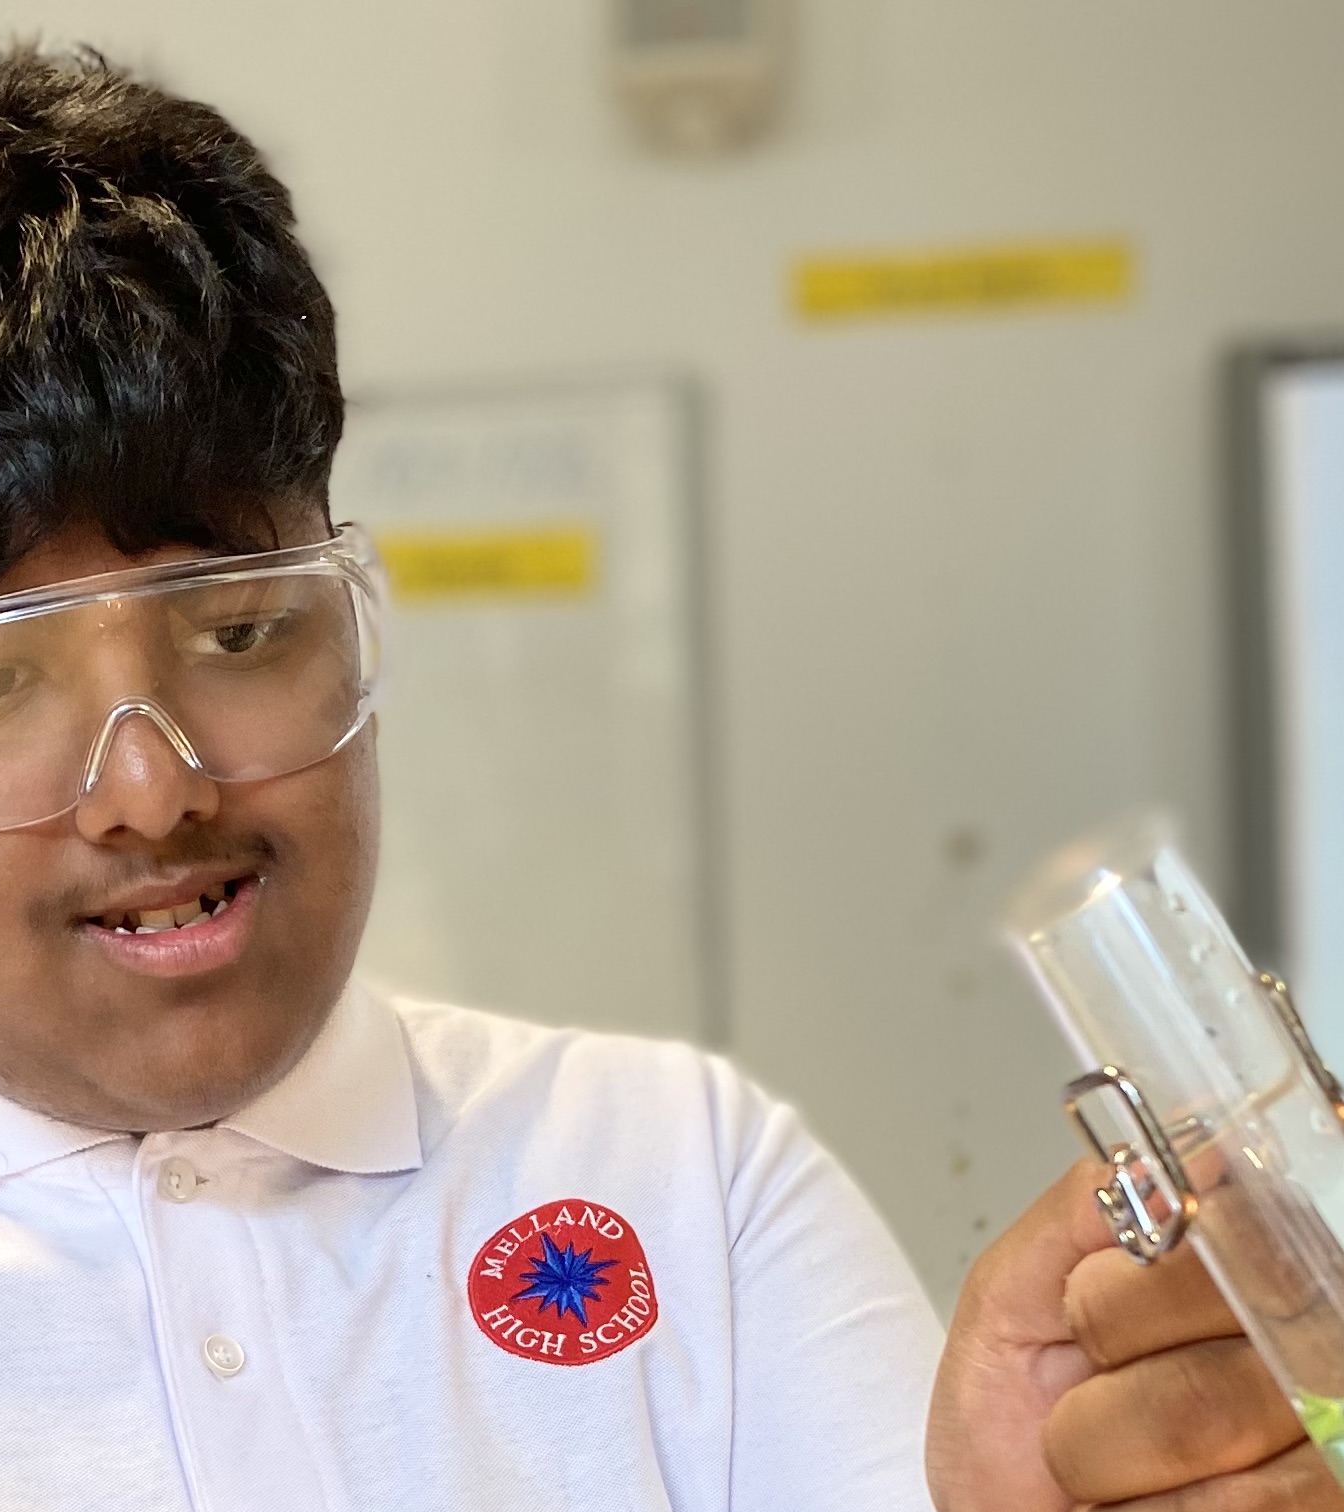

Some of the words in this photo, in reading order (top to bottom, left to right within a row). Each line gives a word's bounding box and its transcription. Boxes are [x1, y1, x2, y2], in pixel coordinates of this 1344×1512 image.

[479, 1205, 624, 1280] MELLAND
[480, 1304, 567, 1357] HIGH
[578, 1261, 651, 1354] SCHOOL
